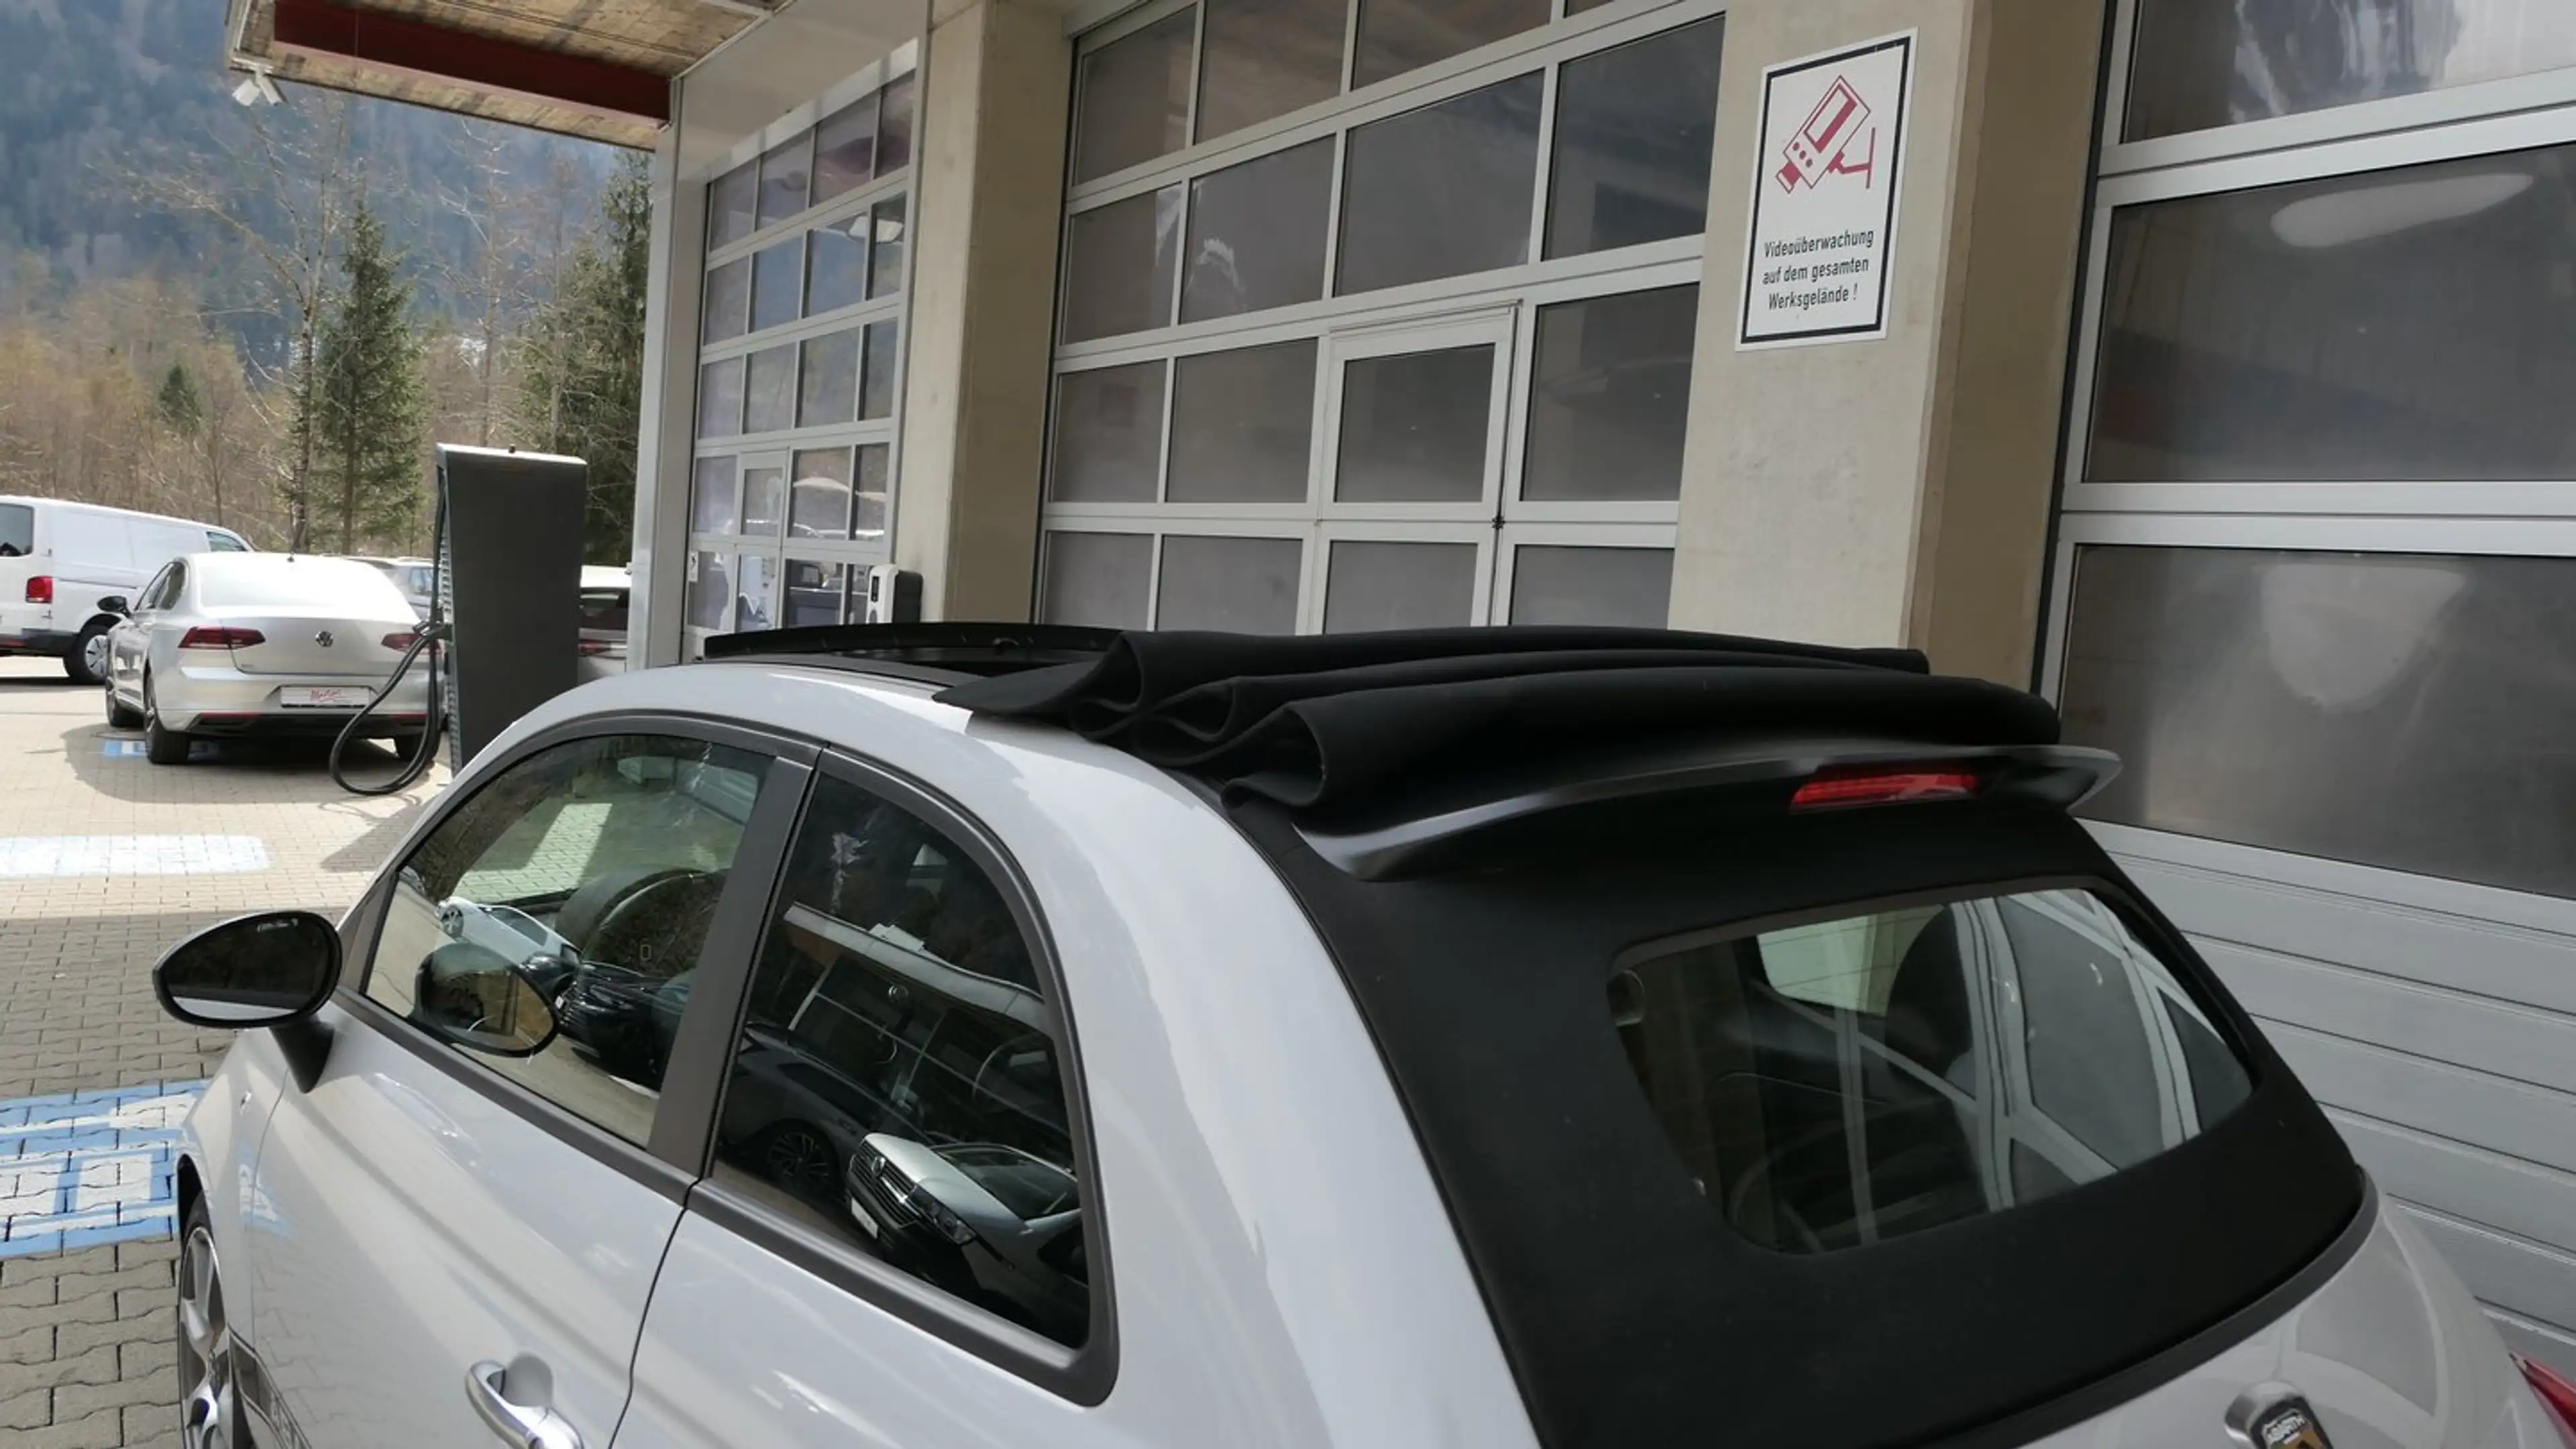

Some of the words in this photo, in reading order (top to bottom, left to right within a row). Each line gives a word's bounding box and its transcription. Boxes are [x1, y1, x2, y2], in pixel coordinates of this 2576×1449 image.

[1764, 229, 1874, 258] Videoüberwachung
[1762, 266, 1782, 285] auf
[1784, 265, 1808, 282] dem
[1811, 257, 1869, 283] gesamten
[1769, 286, 1849, 311] Werksgelände
